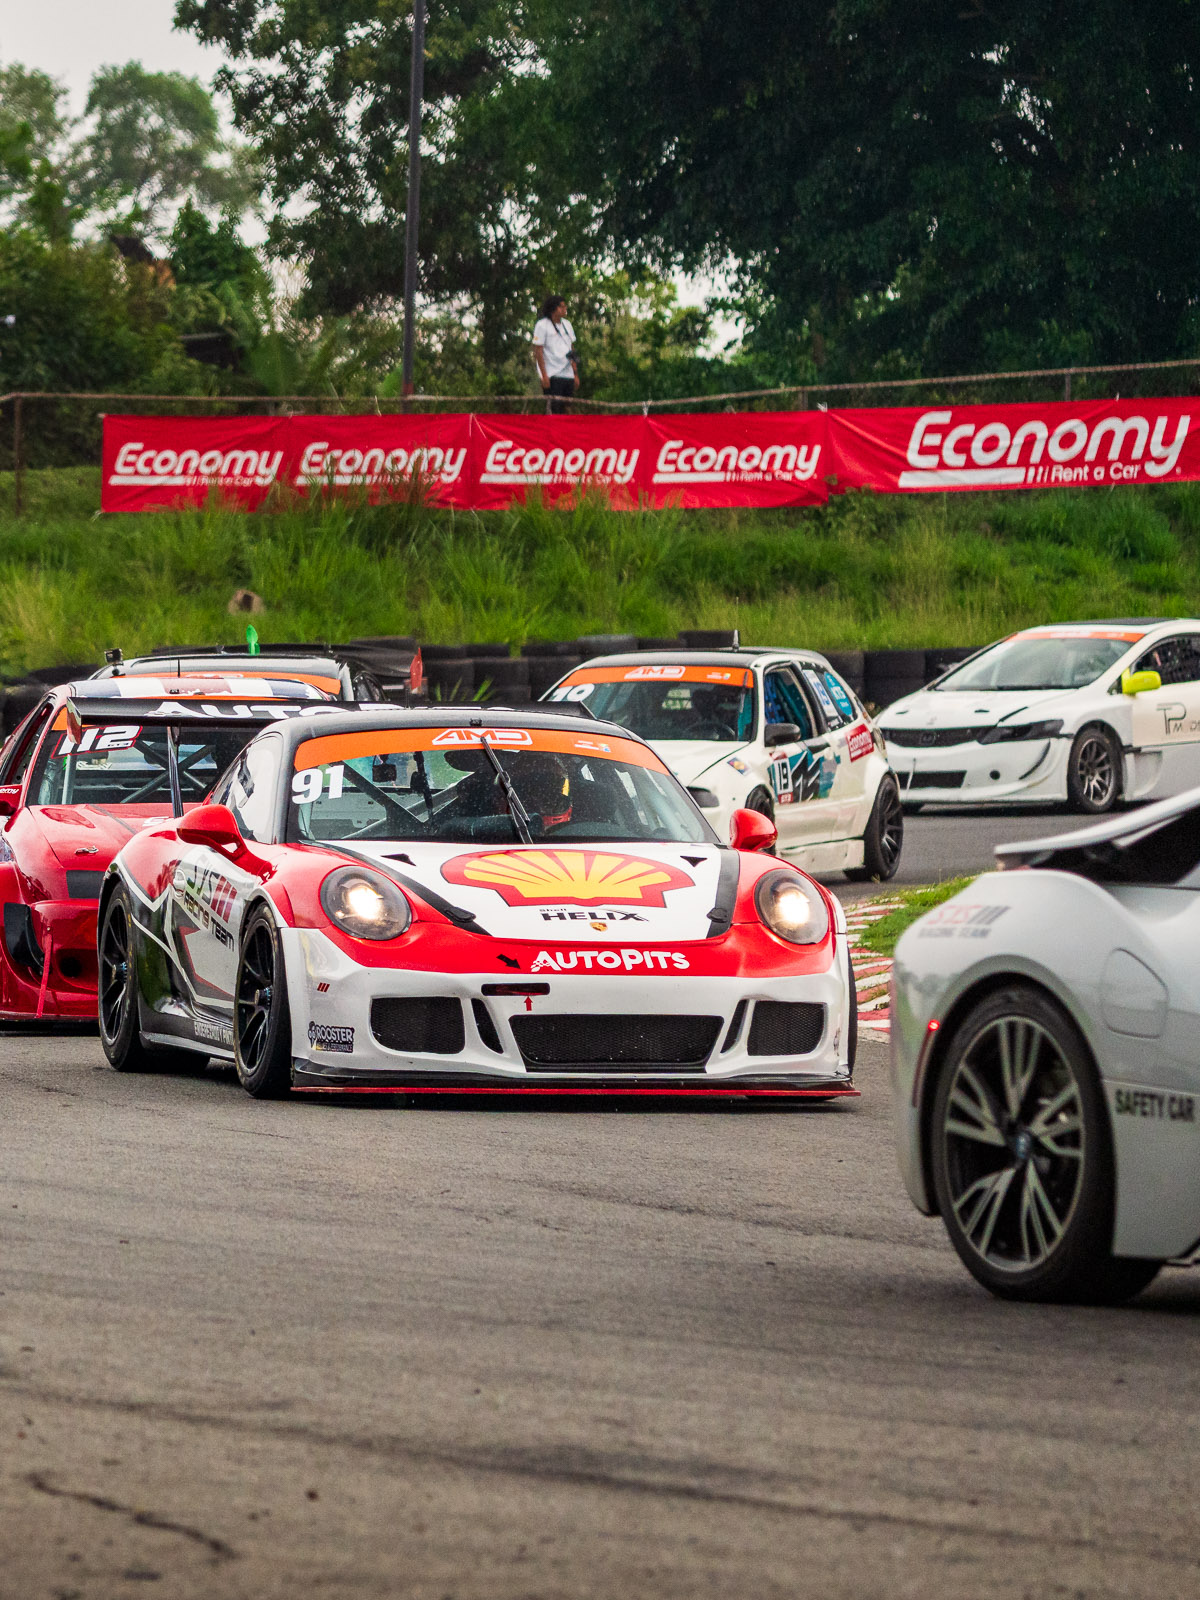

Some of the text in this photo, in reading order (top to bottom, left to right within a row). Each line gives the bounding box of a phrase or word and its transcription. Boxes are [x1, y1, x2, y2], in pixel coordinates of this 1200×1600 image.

[657, 440, 821, 481] Economy
[906, 410, 1191, 478] Economy
[115, 441, 284, 486] Economy
[301, 441, 467, 483] Economy
[485, 440, 640, 484] Economy
[1051, 463, 1142, 484] Rent a Car
[434, 730, 531, 744] AMD
[291, 764, 345, 805] 91
[777, 761, 789, 791] 19
[541, 912, 649, 922] HELIX
[530, 949, 690, 972] AUTOPITS
[315, 1026, 352, 1042] ROOSTER
[1115, 1088, 1195, 1121] SAFETY CAR
